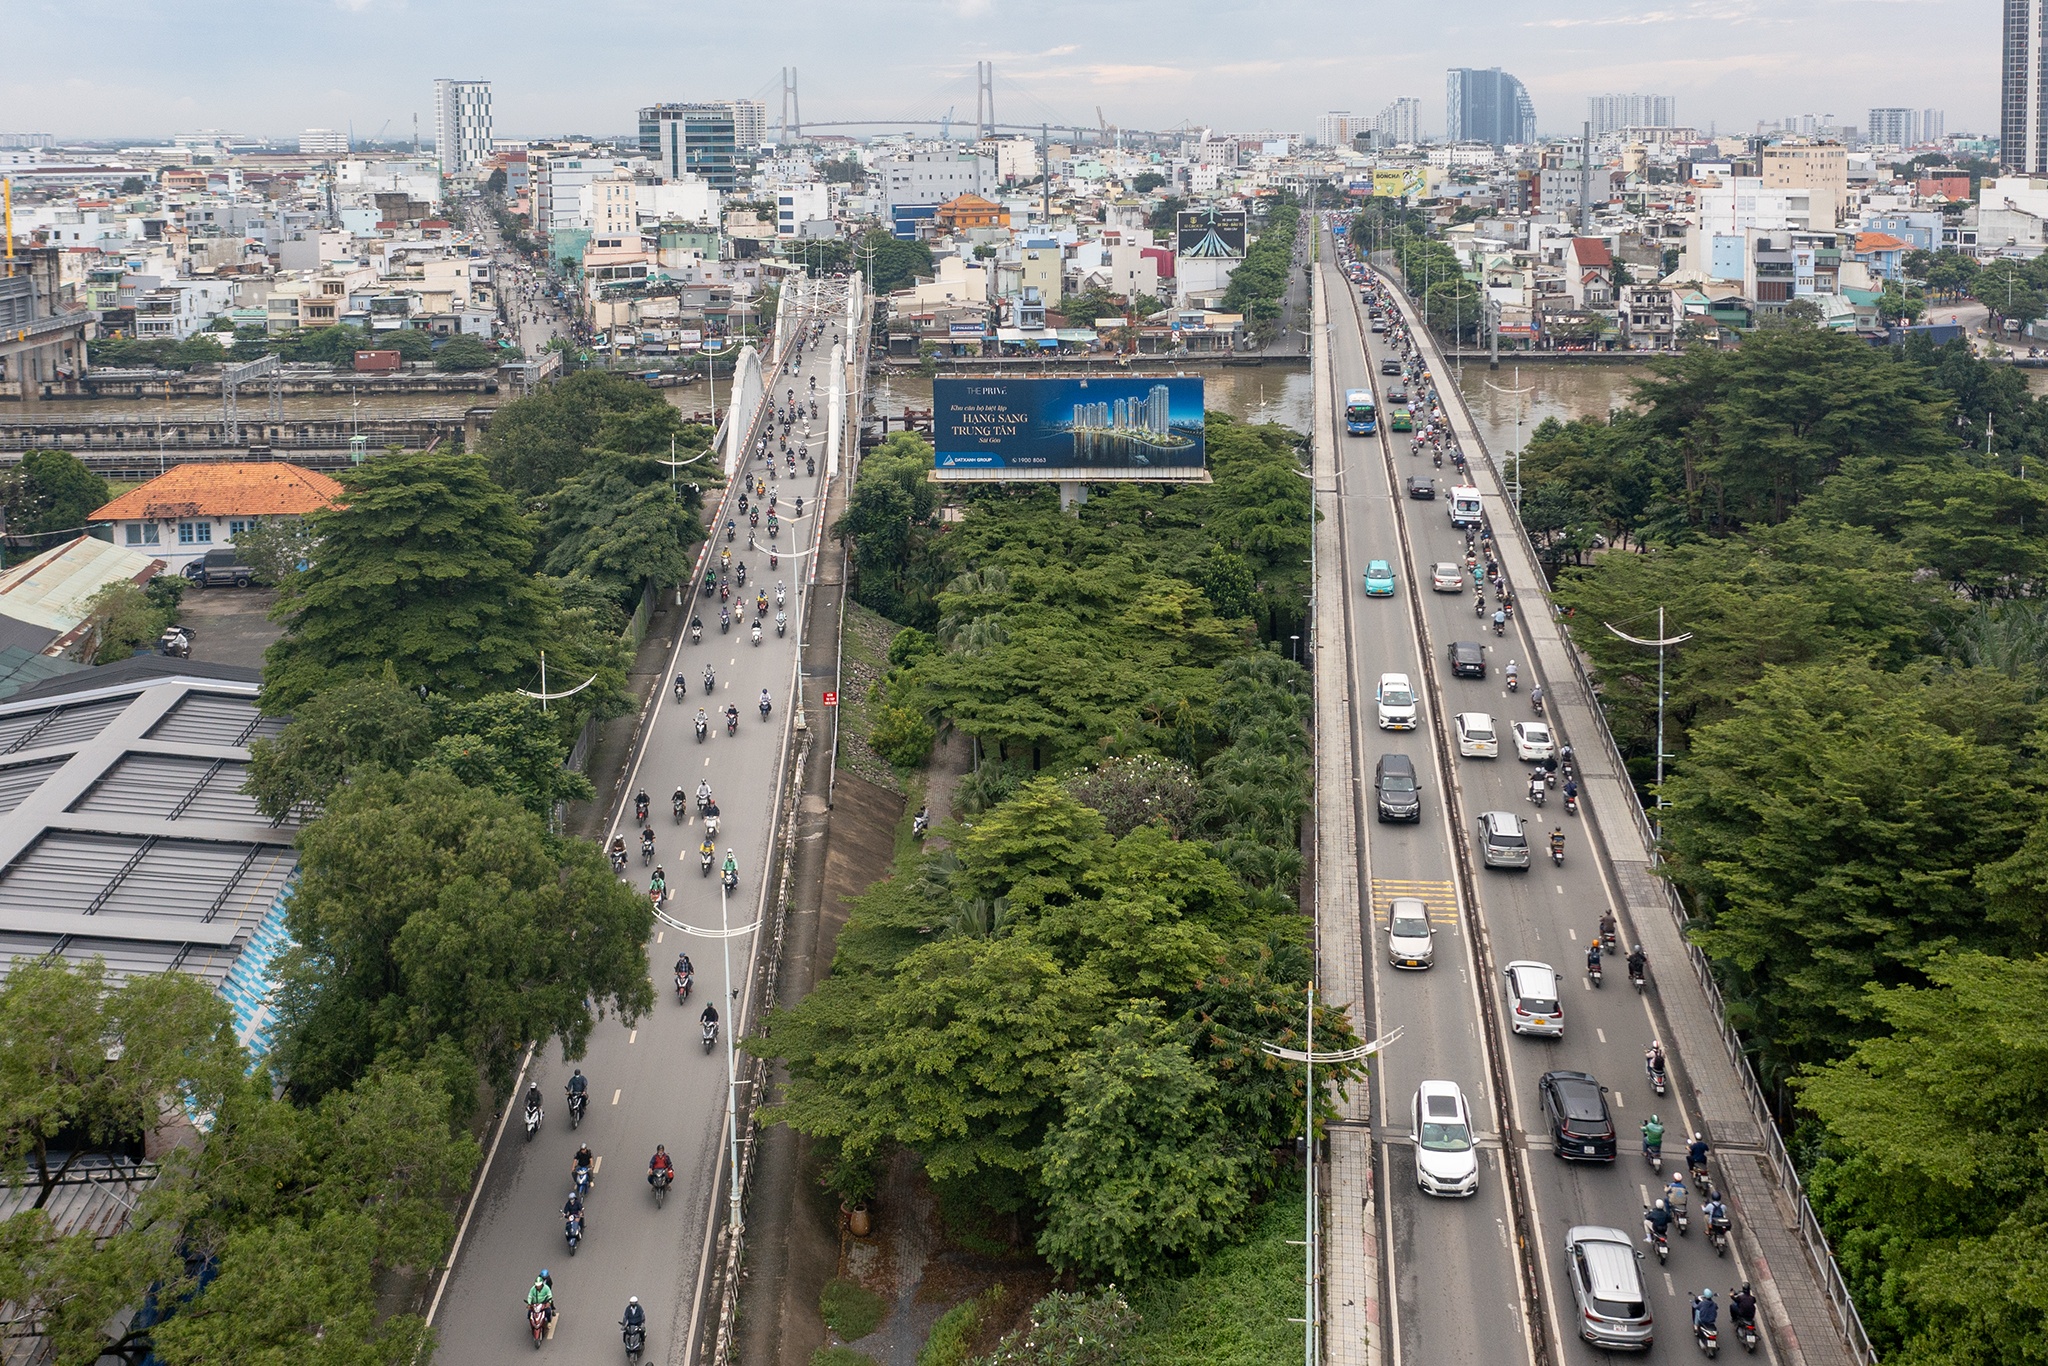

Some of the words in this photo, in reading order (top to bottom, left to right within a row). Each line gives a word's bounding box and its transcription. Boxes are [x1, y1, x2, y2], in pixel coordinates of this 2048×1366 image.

[967, 387, 981, 395] THE
[982, 385, 1007, 395] PRIVÉ
[963, 413, 995, 425] HẠNG
[998, 413, 1028, 424] SANG
[951, 426, 991, 436] TRUNG
[993, 424, 1016, 436] TÂM
